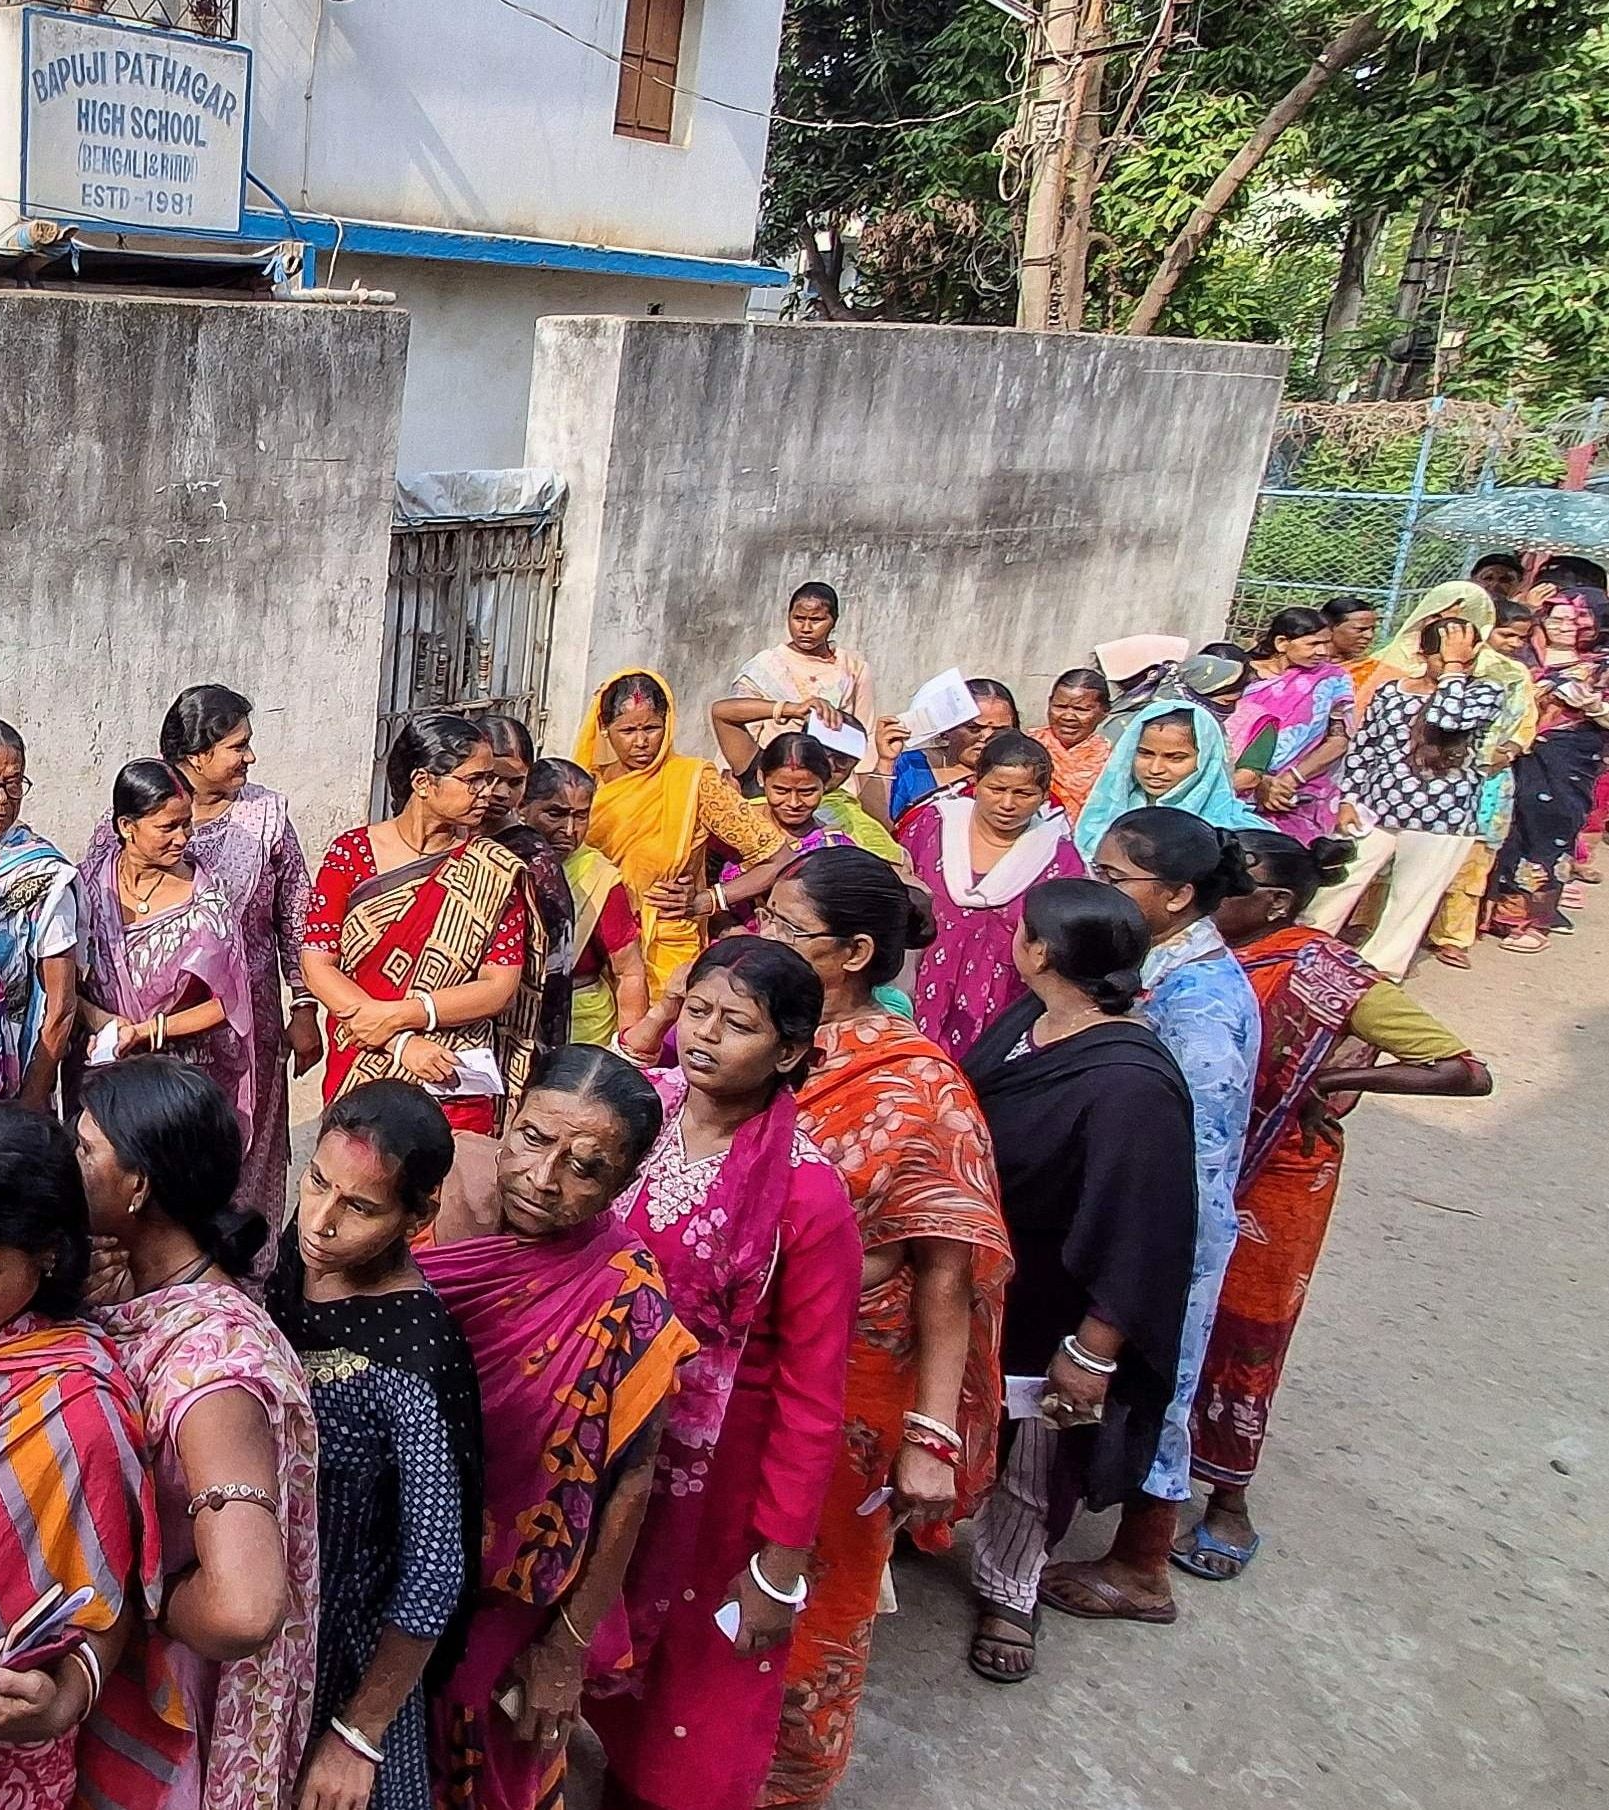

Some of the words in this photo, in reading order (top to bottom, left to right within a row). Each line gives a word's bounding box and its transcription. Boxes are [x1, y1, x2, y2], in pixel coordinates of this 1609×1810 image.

[32, 52, 107, 103] BAPUJI
[115, 51, 237, 126] PATHAGAR
[77, 98, 125, 137] HIGH
[130, 106, 207, 148] SCHOOL
